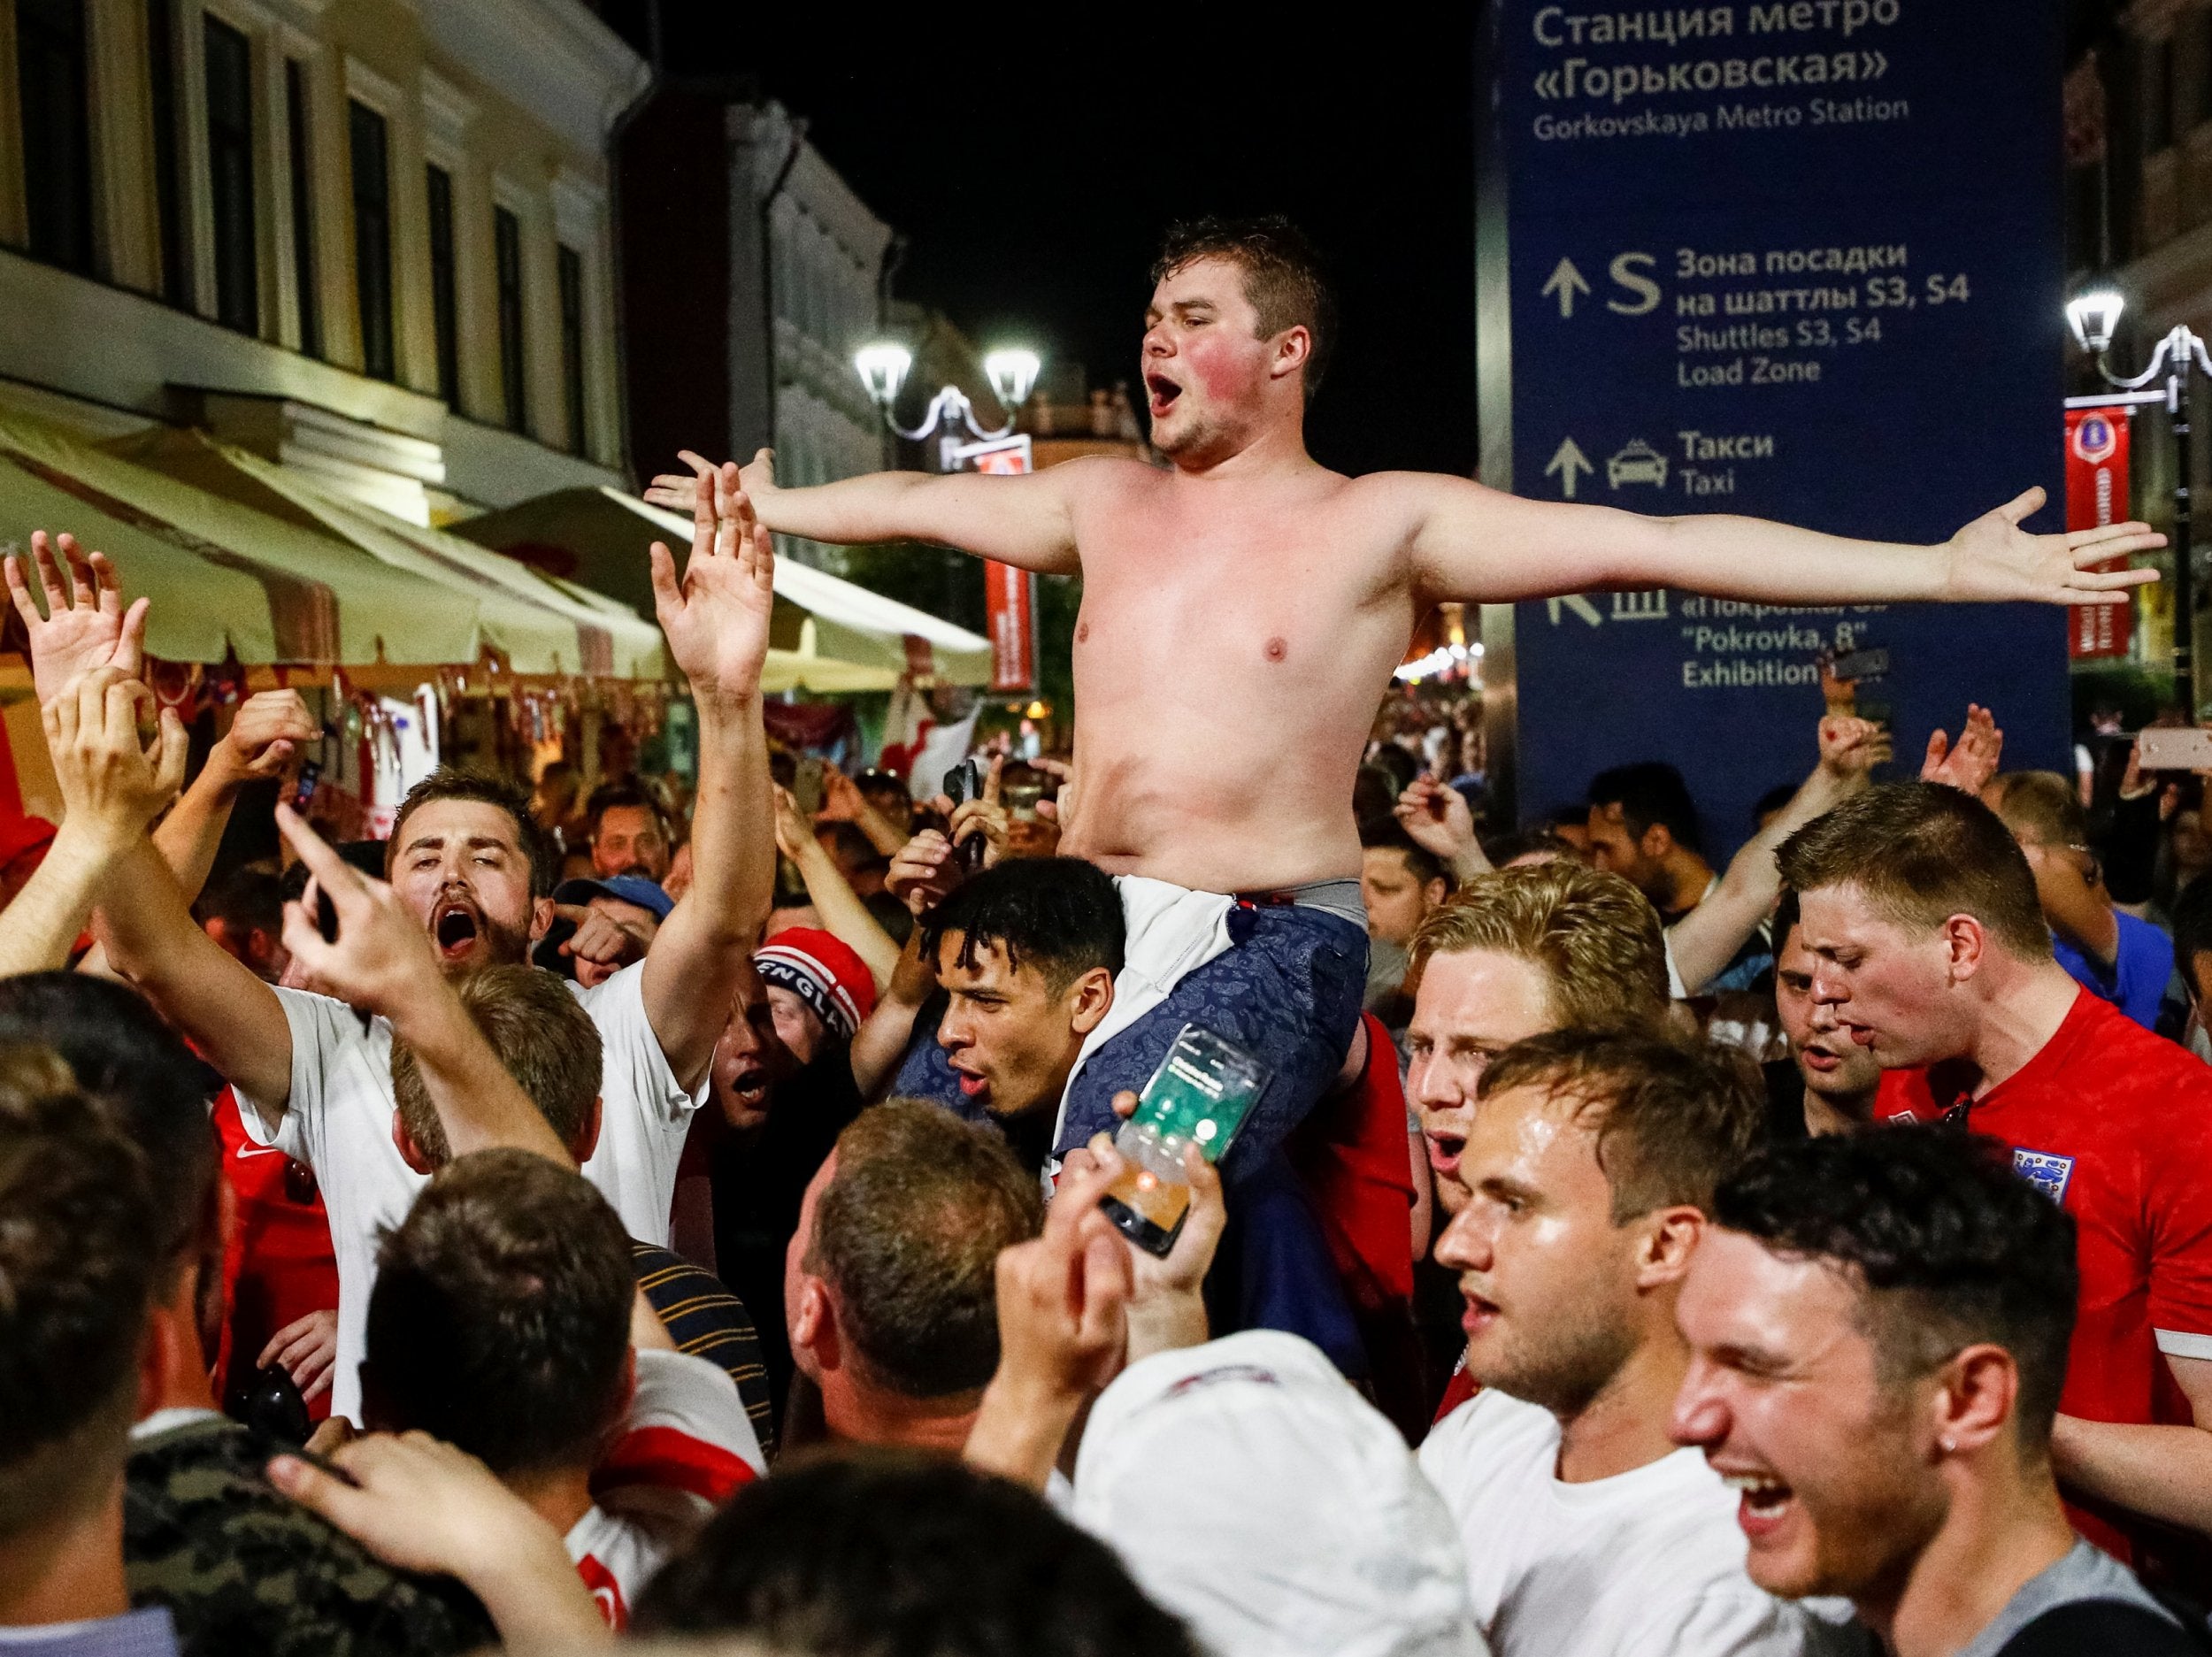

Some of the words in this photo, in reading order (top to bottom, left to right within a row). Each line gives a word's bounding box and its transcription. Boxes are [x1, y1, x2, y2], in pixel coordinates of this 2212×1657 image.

[1533, 5, 1734, 47] Станция
[1748, 0, 1901, 37] метро
[1534, 49, 1889, 105] «Горьковская»
[1533, 108, 1709, 141] Gorkovskaya
[1717, 104, 1802, 129] Metro
[1809, 96, 1909, 125] Station
[1677, 248, 1757, 279] Зона
[1766, 243, 1908, 274] посадки
[1606, 251, 1662, 316] S
[1677, 293, 1717, 317] на
[1724, 286, 1857, 315] шаттлы
[1866, 275, 1916, 310] S3,
[1926, 273, 1970, 305] S4
[1677, 323, 1789, 352] Shuttles
[1796, 318, 1839, 348] S3,
[1846, 316, 1883, 345] S4
[1678, 358, 1744, 387] Load
[1750, 355, 1822, 385] Zone
[1678, 430, 1775, 460] Такси
[1678, 468, 1735, 495] Taxi
[1683, 659, 1819, 688] Exhibition
